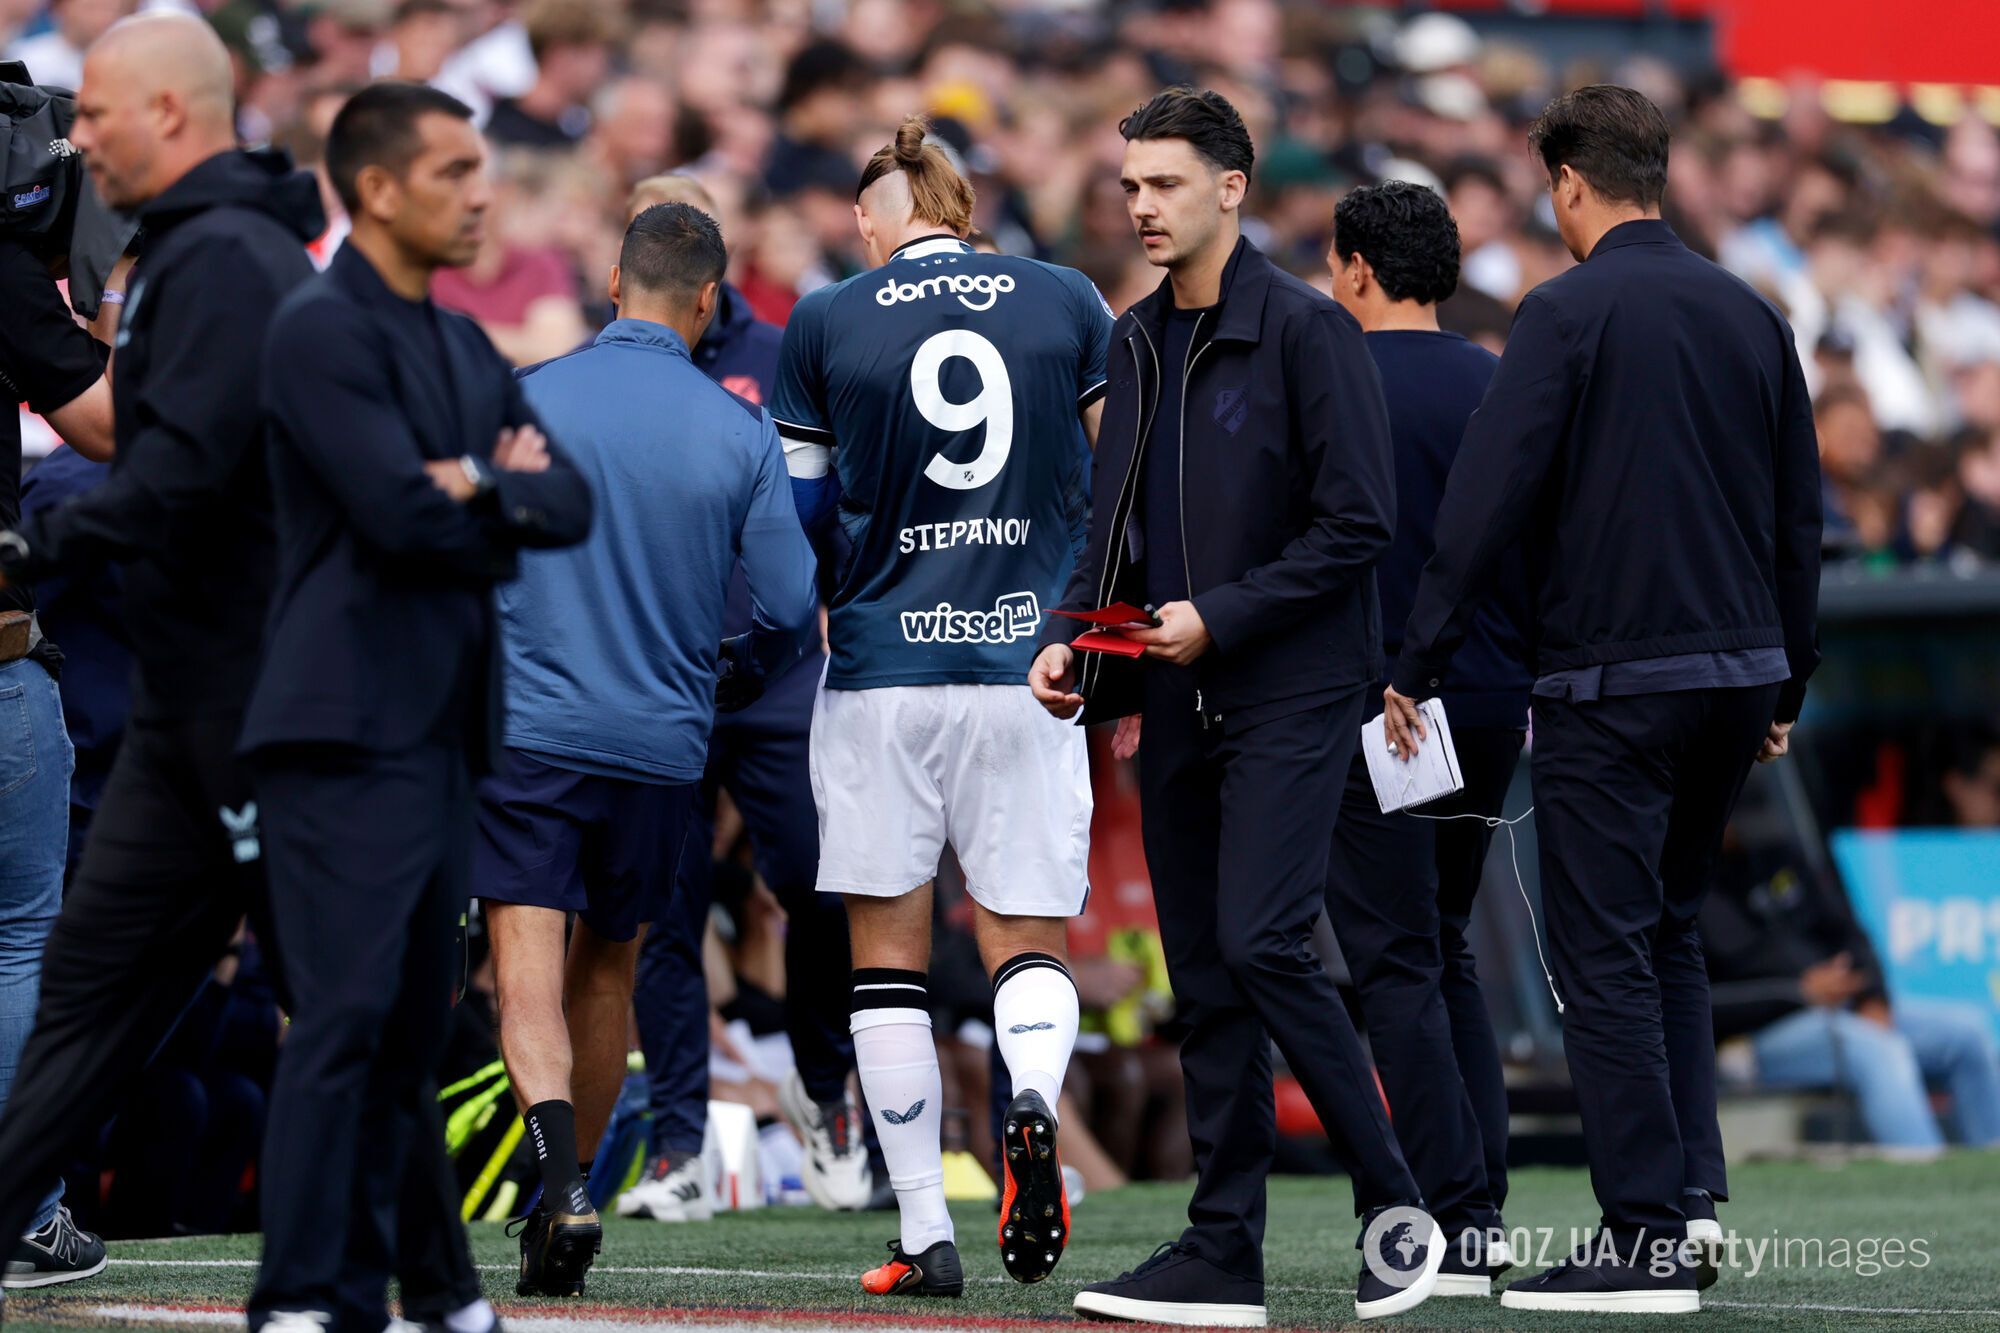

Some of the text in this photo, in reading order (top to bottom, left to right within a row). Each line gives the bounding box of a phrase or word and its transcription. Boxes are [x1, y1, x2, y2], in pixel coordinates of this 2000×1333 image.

[876, 274, 1015, 311] domogo
[910, 329, 1013, 490] 9
[899, 518, 1031, 554] STEPANOV
[530, 1116, 548, 1161] CASTORE
